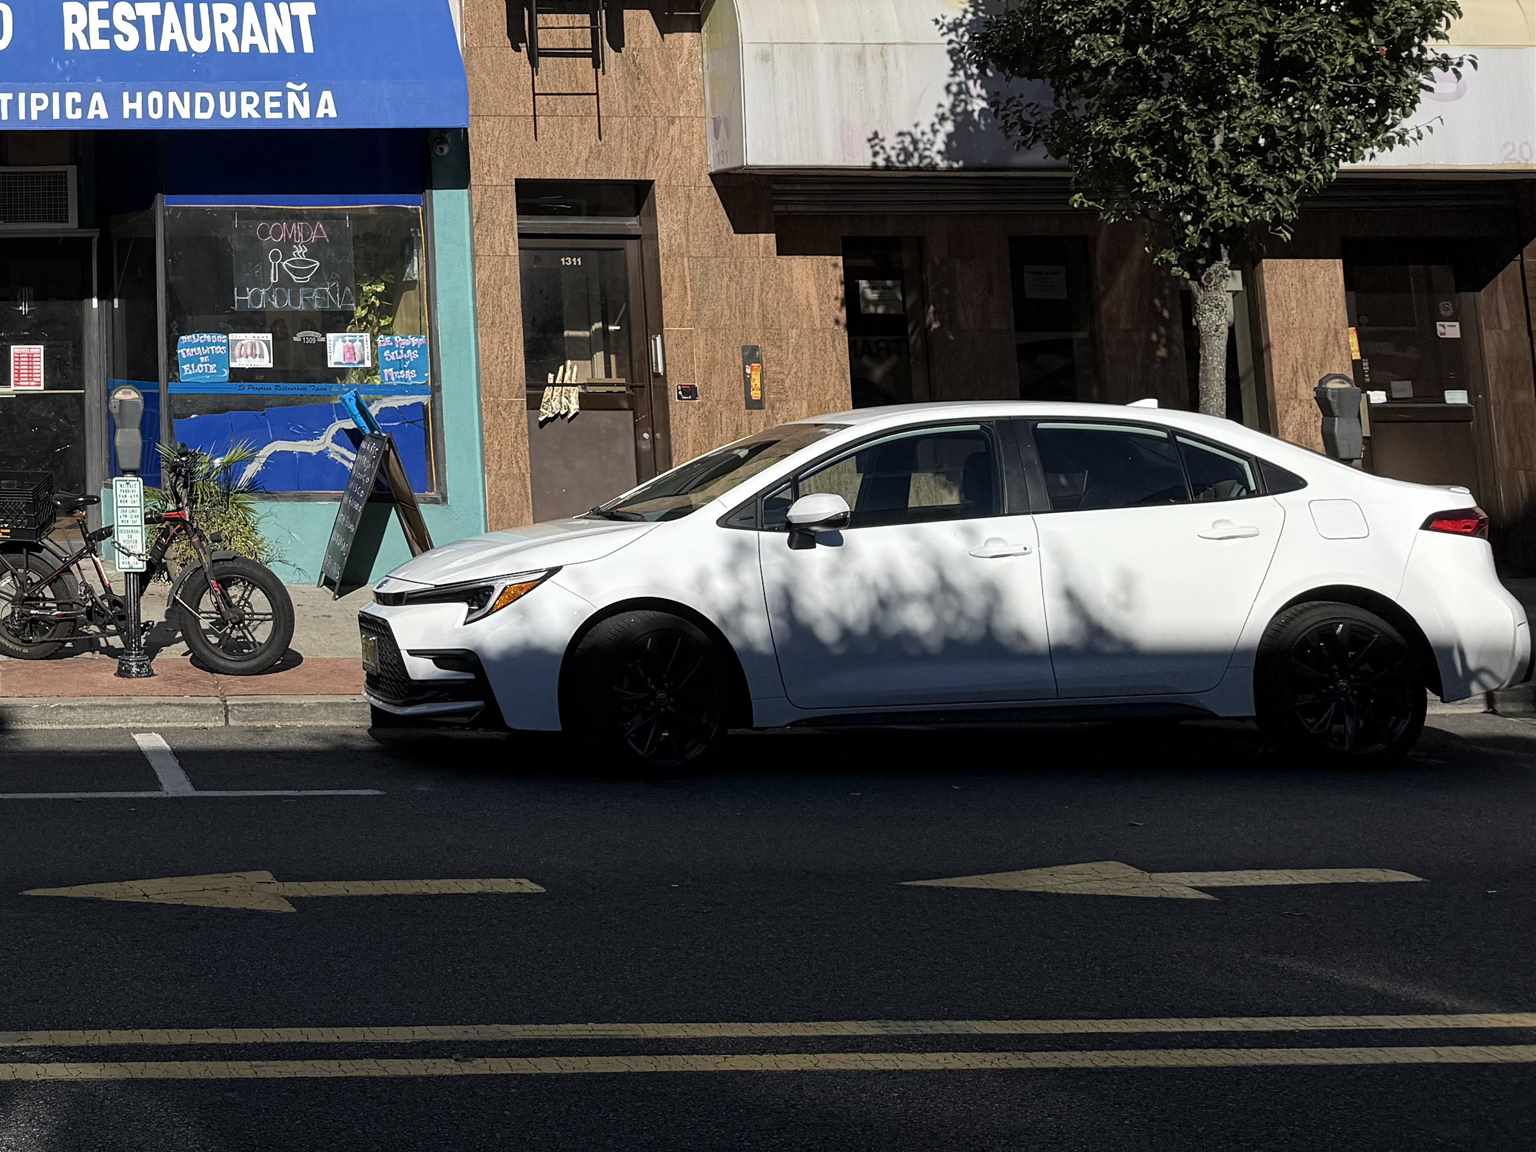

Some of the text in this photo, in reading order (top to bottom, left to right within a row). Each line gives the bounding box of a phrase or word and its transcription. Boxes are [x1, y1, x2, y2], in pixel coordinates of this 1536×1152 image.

[63, 0, 317, 54] RESTAURANT
[122, 81, 338, 120] HONDUREÑA
[256, 221, 330, 243] COMIDA
[560, 256, 582, 266] 1311
[182, 363, 217, 376] ELOTE
